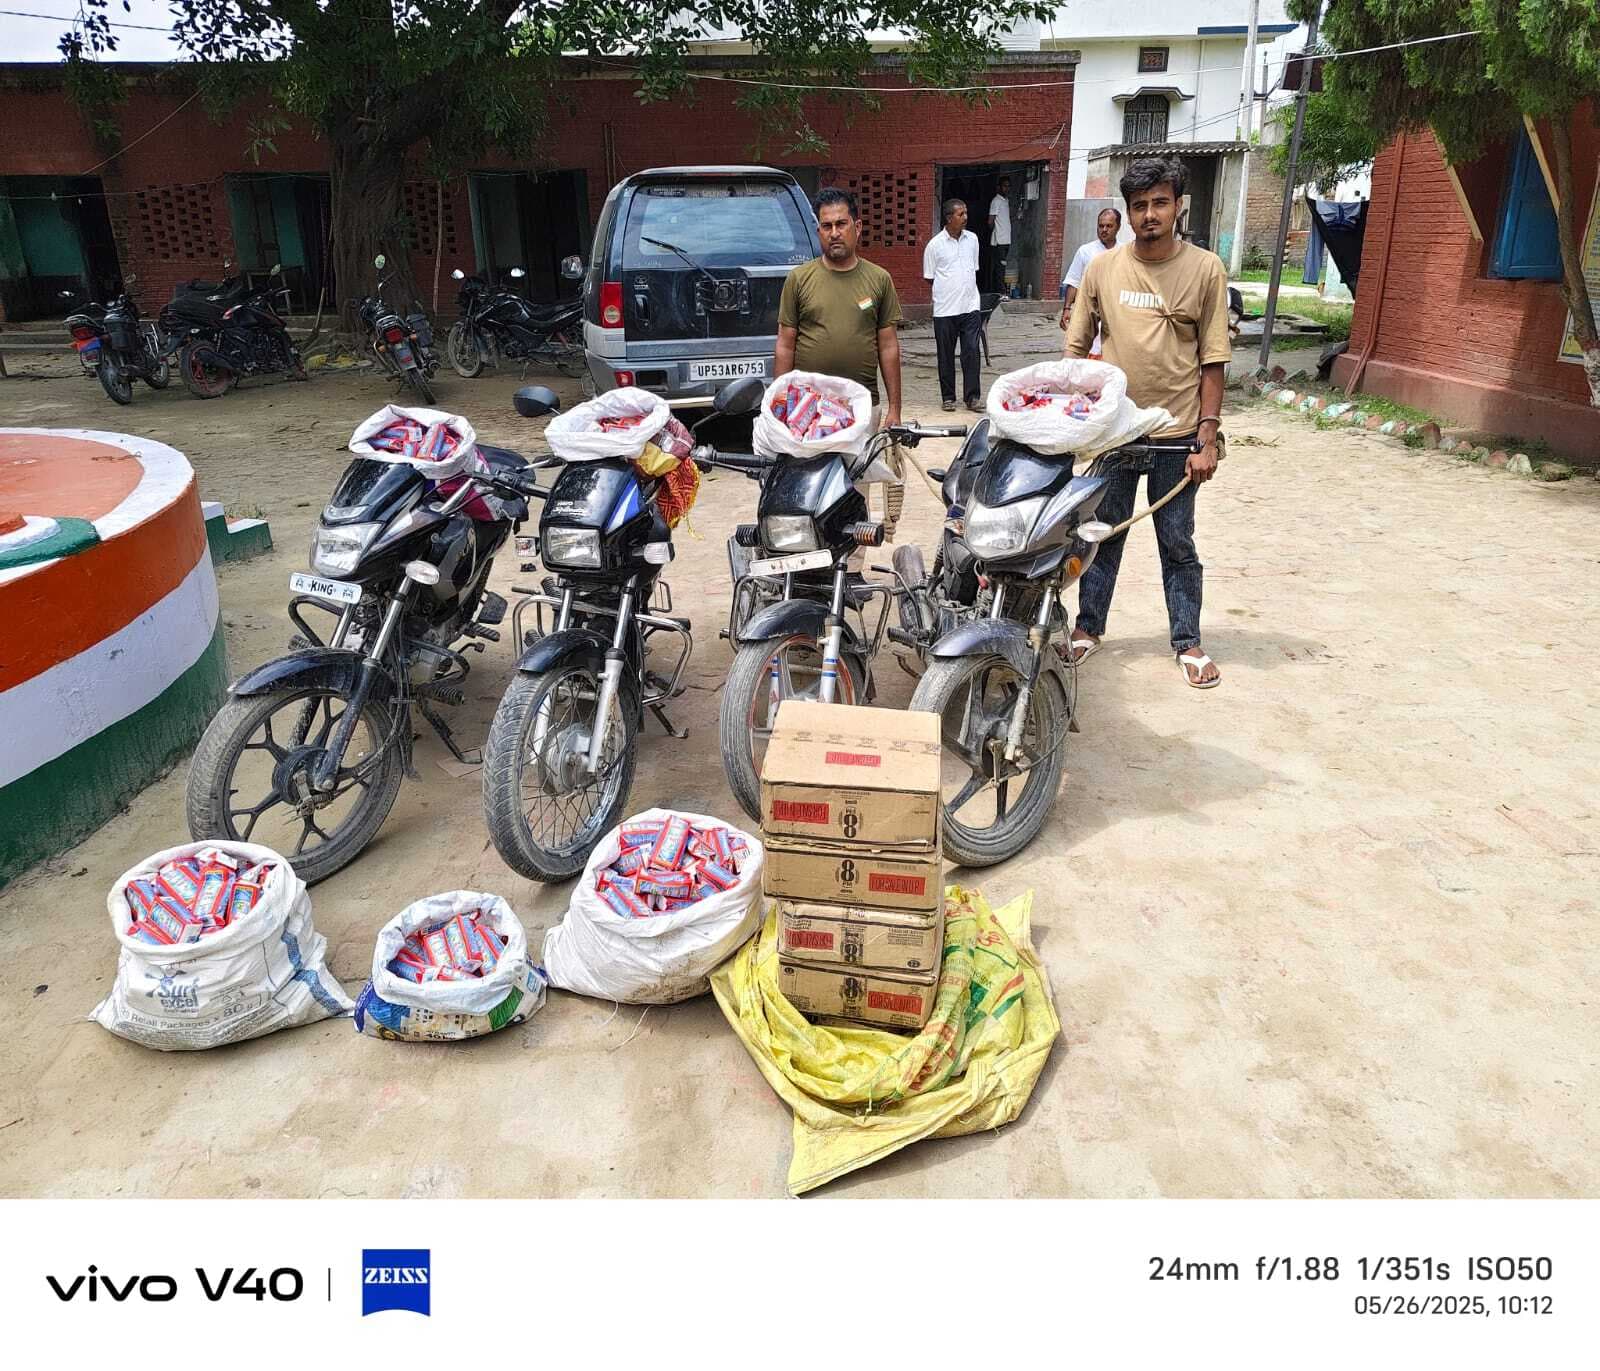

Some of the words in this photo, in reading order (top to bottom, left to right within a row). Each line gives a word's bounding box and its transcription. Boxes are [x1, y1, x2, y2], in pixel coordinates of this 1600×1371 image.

[697, 362, 764, 377] UP53AR6753
[310, 580, 334, 596] KING
[843, 814, 858, 839] 8
[840, 859, 855, 882] 8
[158, 976, 200, 998] Surf
